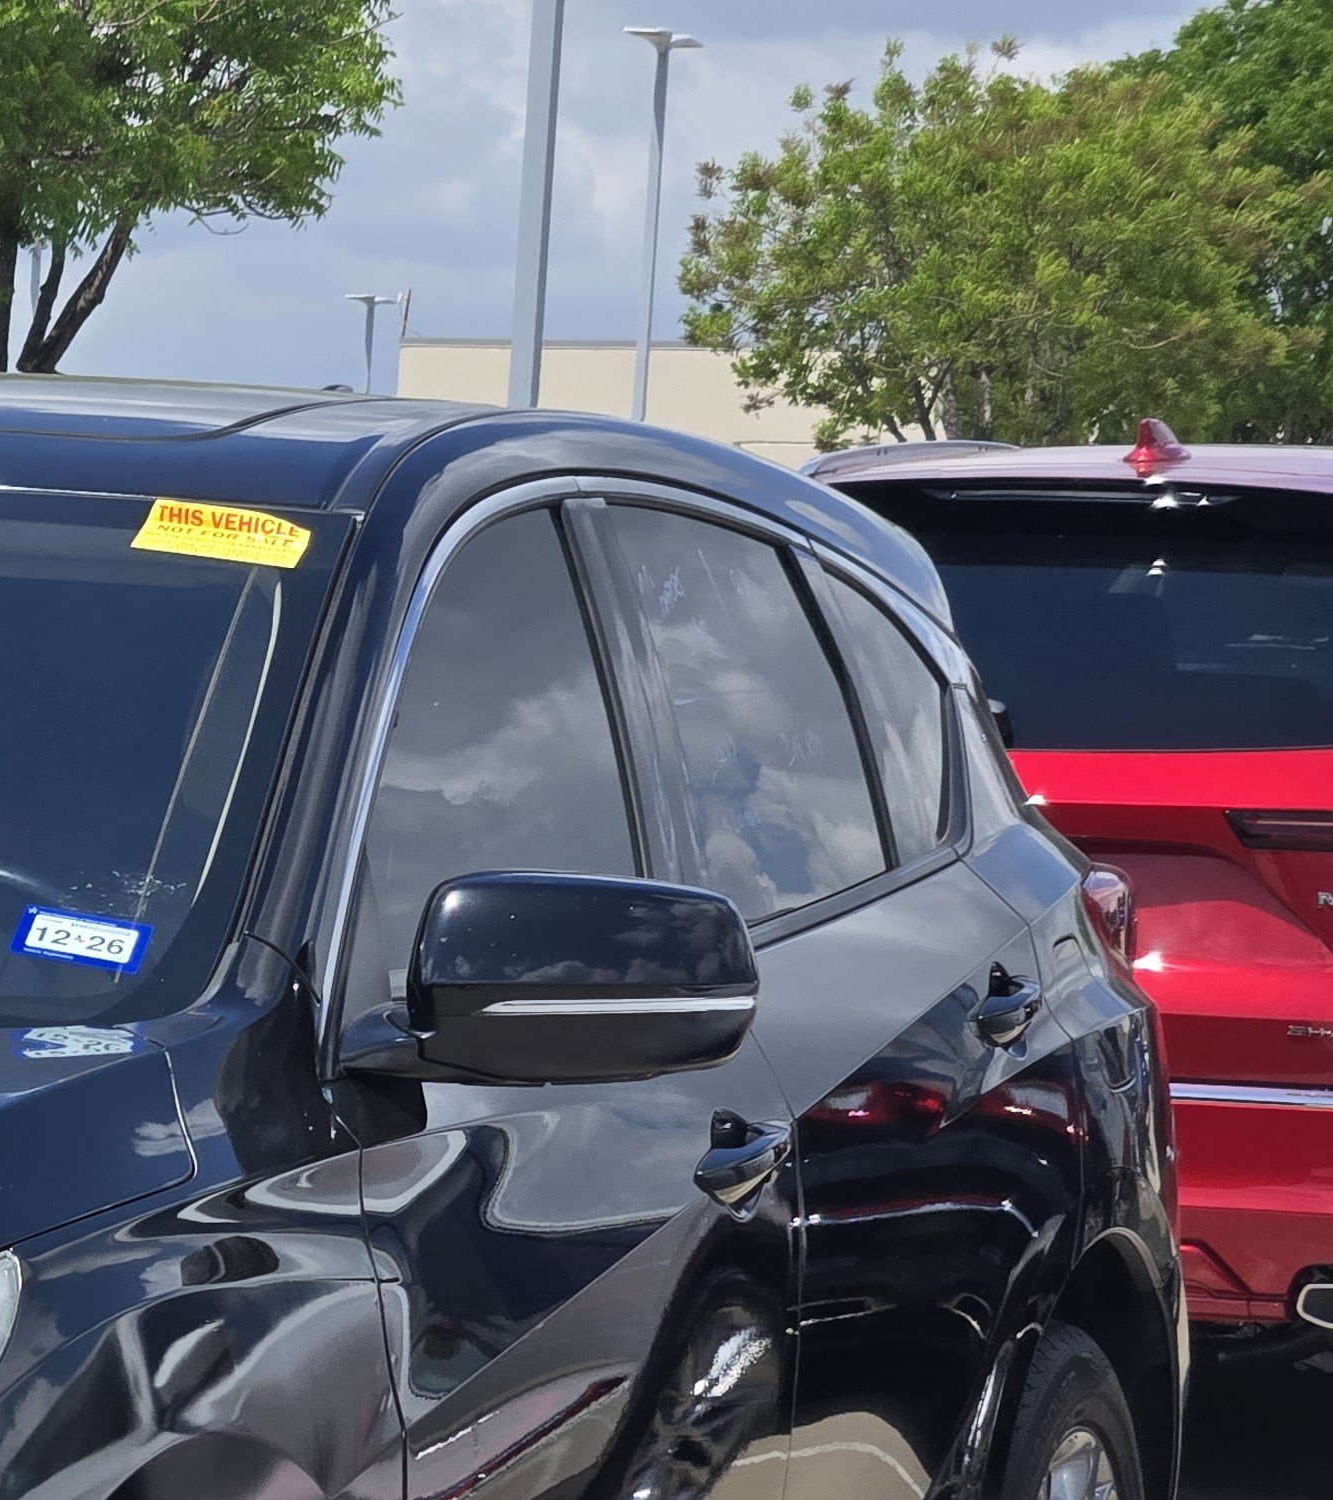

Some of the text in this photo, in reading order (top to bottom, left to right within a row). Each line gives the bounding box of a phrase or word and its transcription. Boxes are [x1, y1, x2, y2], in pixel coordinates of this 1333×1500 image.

[157, 524, 193, 535] NOT
[200, 529, 239, 541] FOR
[158, 505, 300, 538] THIS VEHICLE
[35, 926, 71, 946] 12
[85, 935, 124, 955] 26
